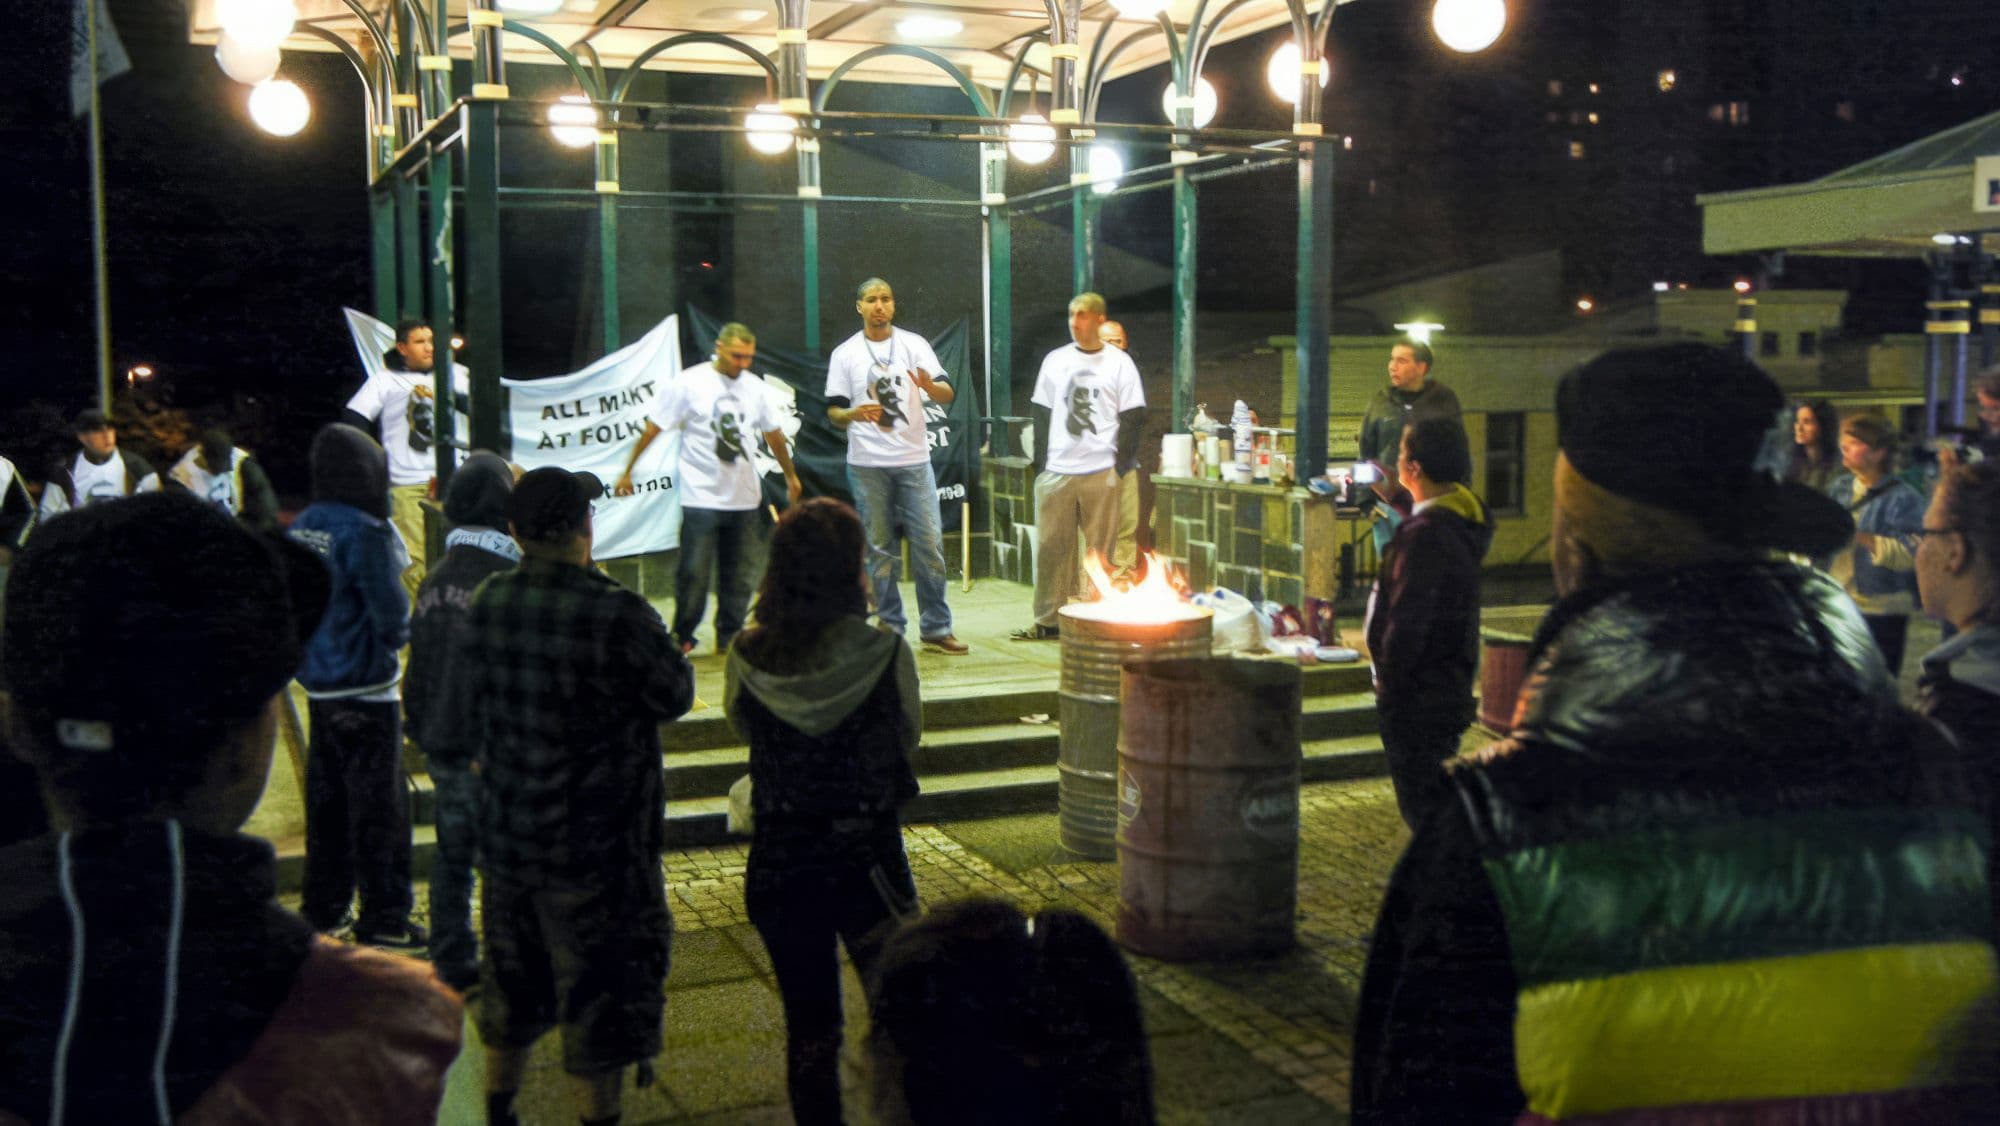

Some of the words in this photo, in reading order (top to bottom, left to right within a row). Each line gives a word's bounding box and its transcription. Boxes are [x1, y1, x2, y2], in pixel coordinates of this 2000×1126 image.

[541, 400, 590, 421] ALL
[579, 414, 649, 446] FOLK
[925, 426, 951, 451] RT
